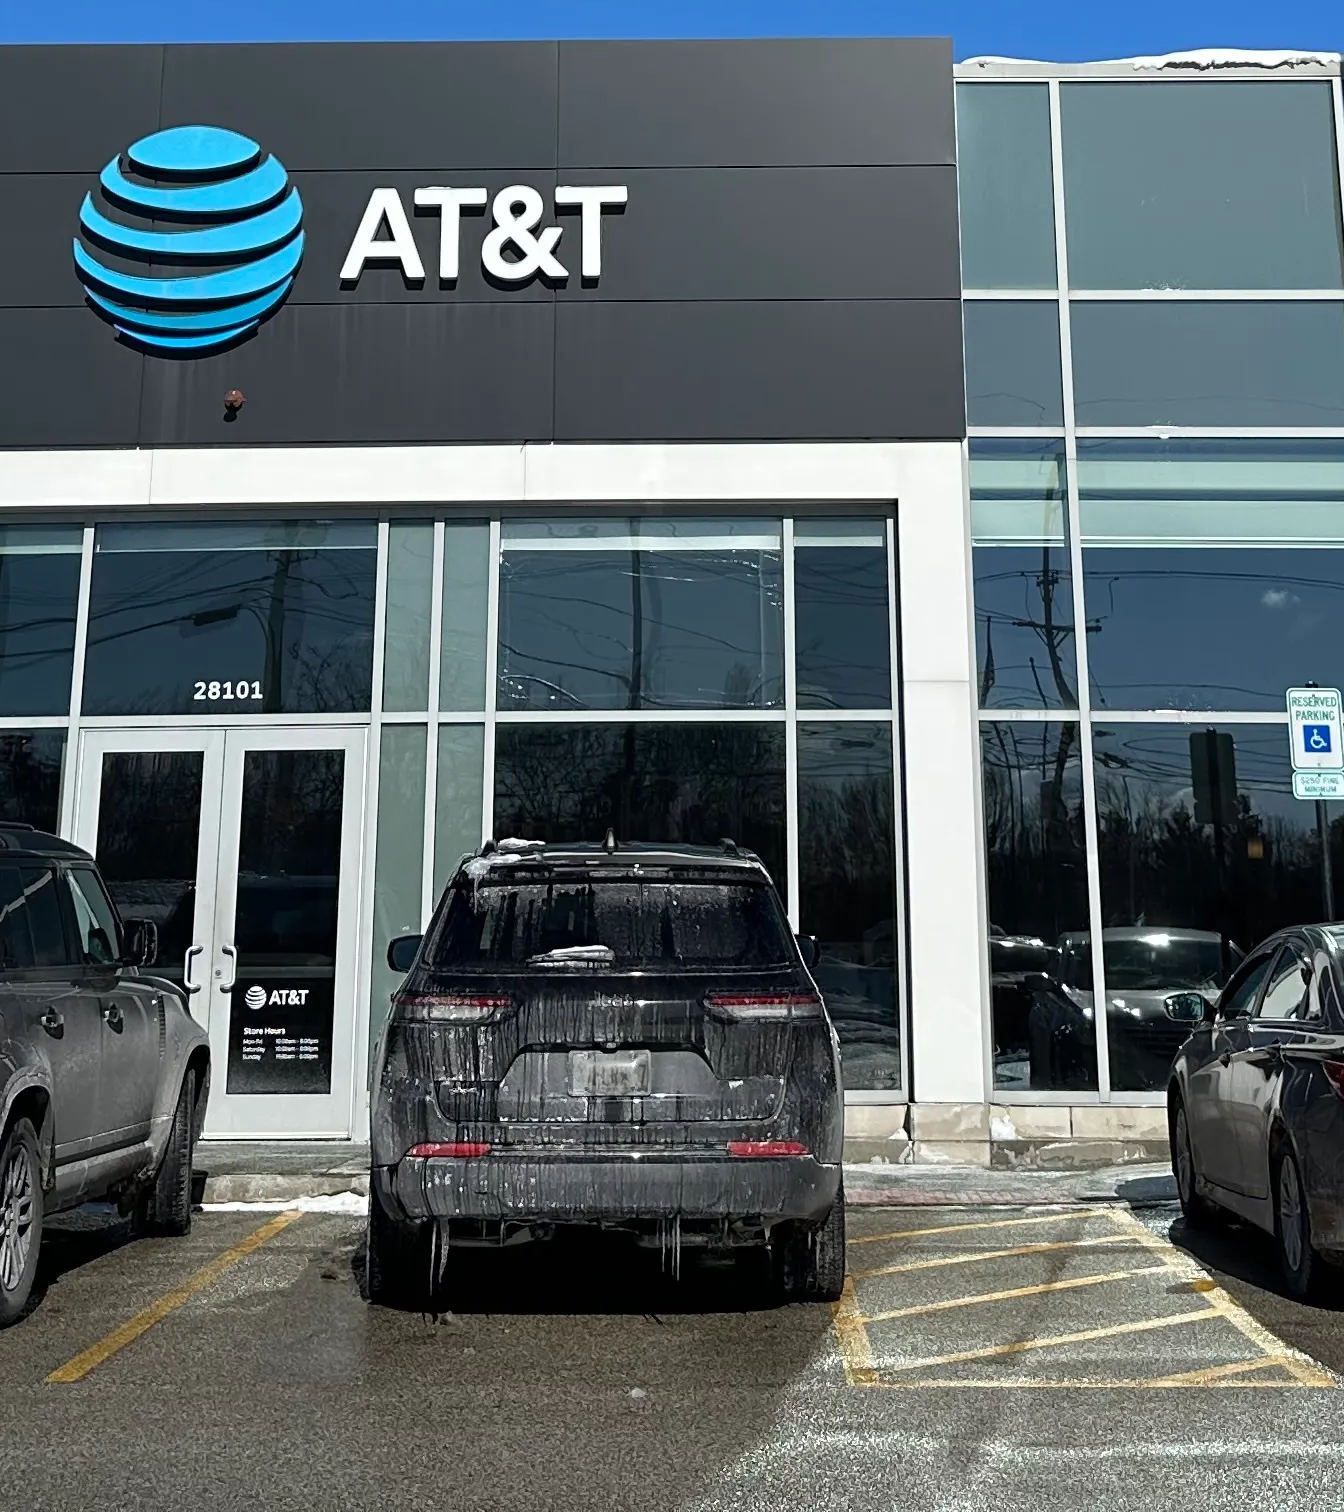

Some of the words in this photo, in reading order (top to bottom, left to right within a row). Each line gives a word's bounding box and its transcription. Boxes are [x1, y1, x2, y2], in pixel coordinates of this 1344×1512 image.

[339, 185, 628, 280] AT&T
[193, 680, 263, 700] 28101
[1291, 696, 1337, 707] RESERVED
[1295, 710, 1335, 721] PARKING
[268, 989, 310, 1006] AT&T
[243, 1027, 263, 1035] Store
[264, 1027, 286, 1035] Hours
